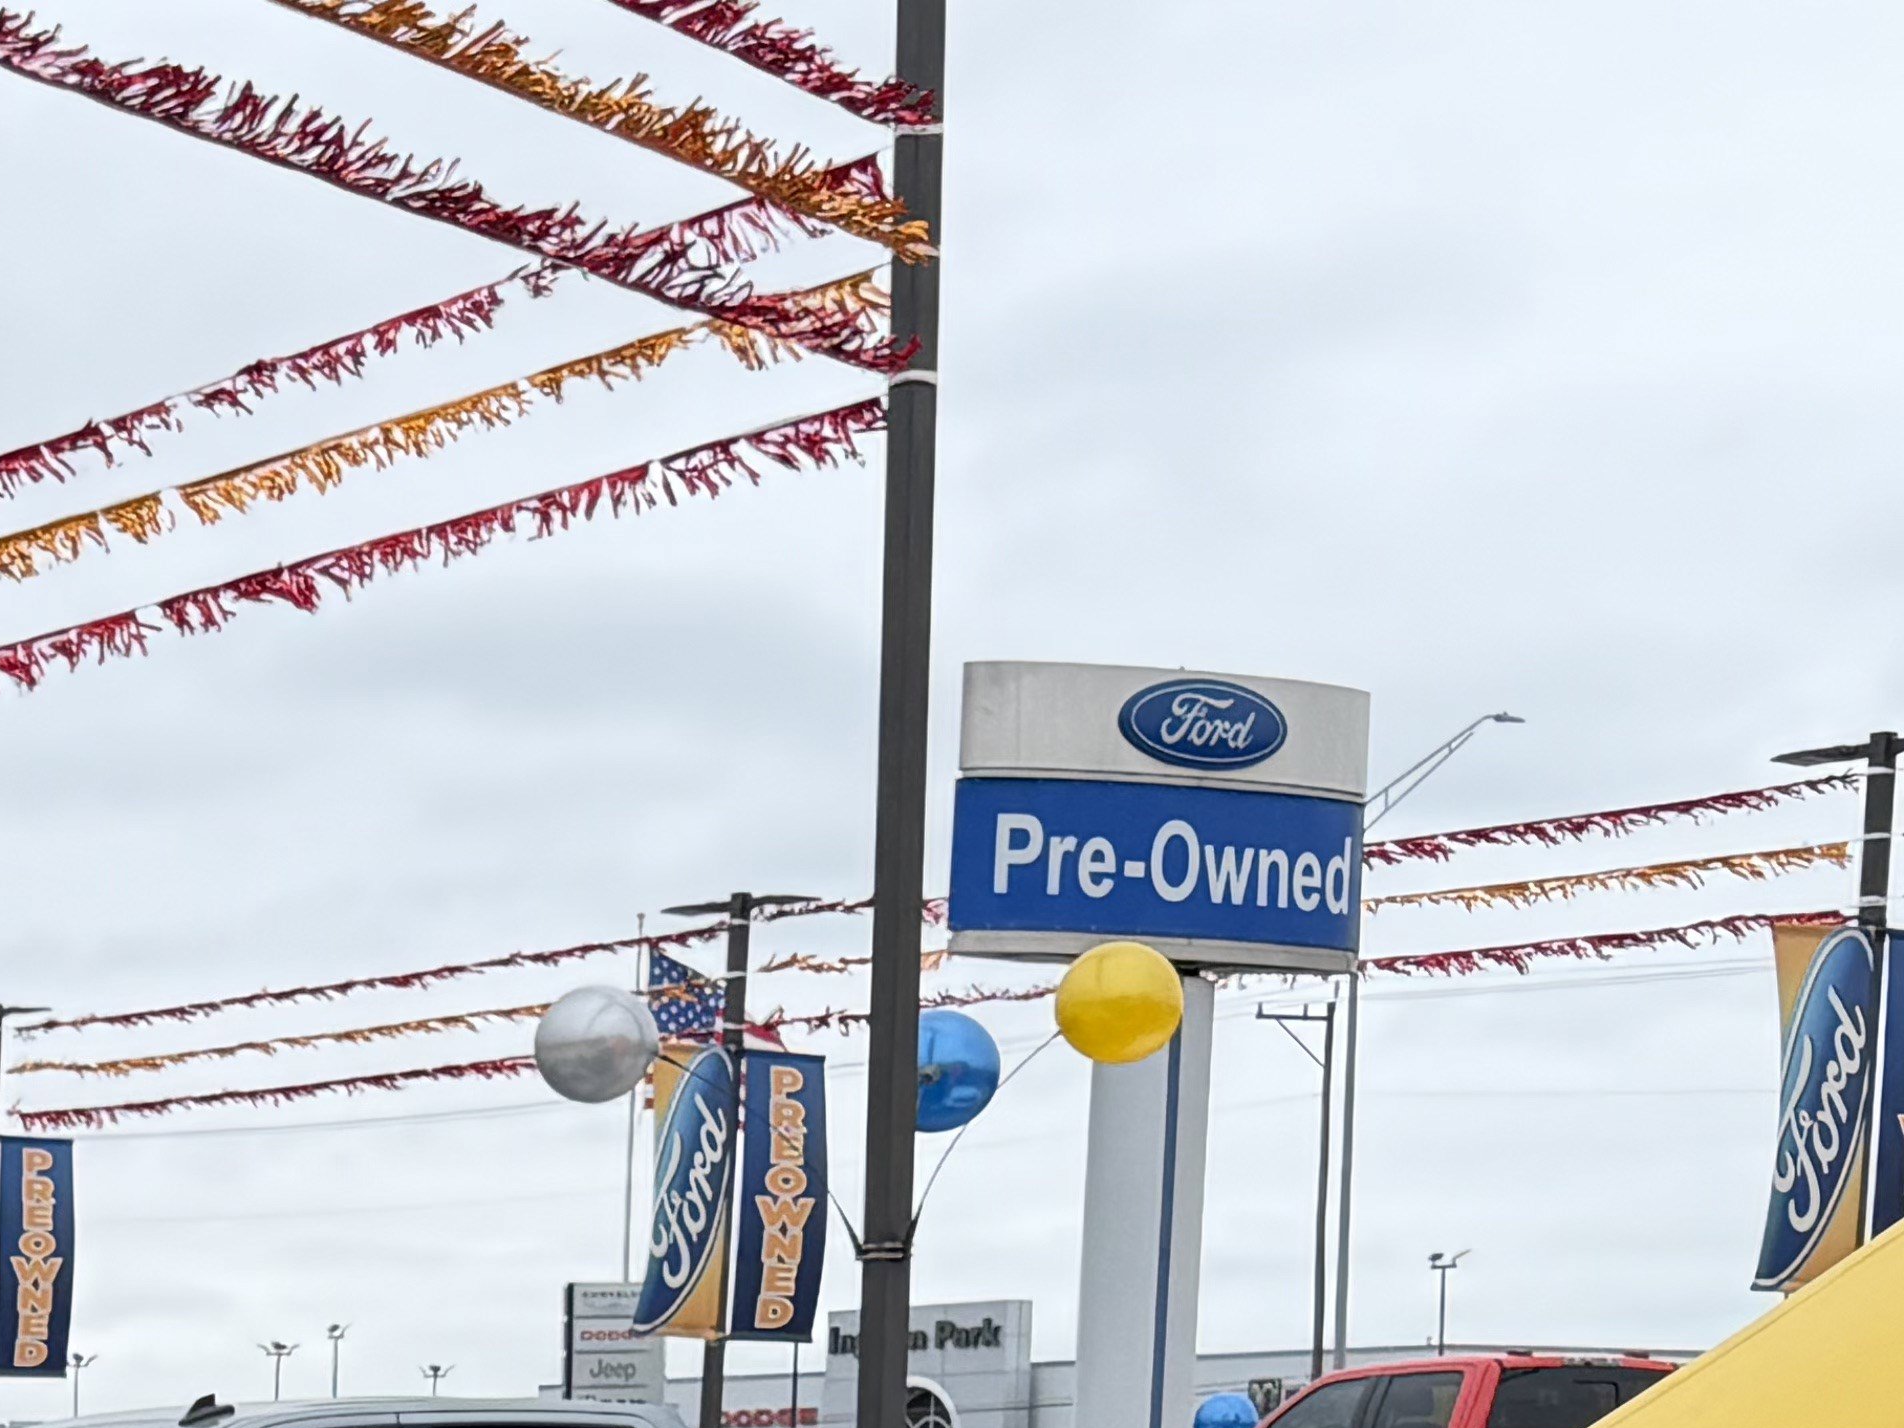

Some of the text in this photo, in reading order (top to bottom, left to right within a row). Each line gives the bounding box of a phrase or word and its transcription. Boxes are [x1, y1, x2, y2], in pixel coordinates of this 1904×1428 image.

[1160, 692, 1256, 750] Ford
[993, 812, 1353, 916] Pre-Owned
[1773, 984, 1867, 1234] Ford
[10, 1147, 64, 1367] PREOWNED
[650, 1092, 726, 1290] Ford
[754, 1065, 816, 1330] PREOWNED
[589, 1358, 637, 1381] Jeep
[935, 1317, 1003, 1351] Park
